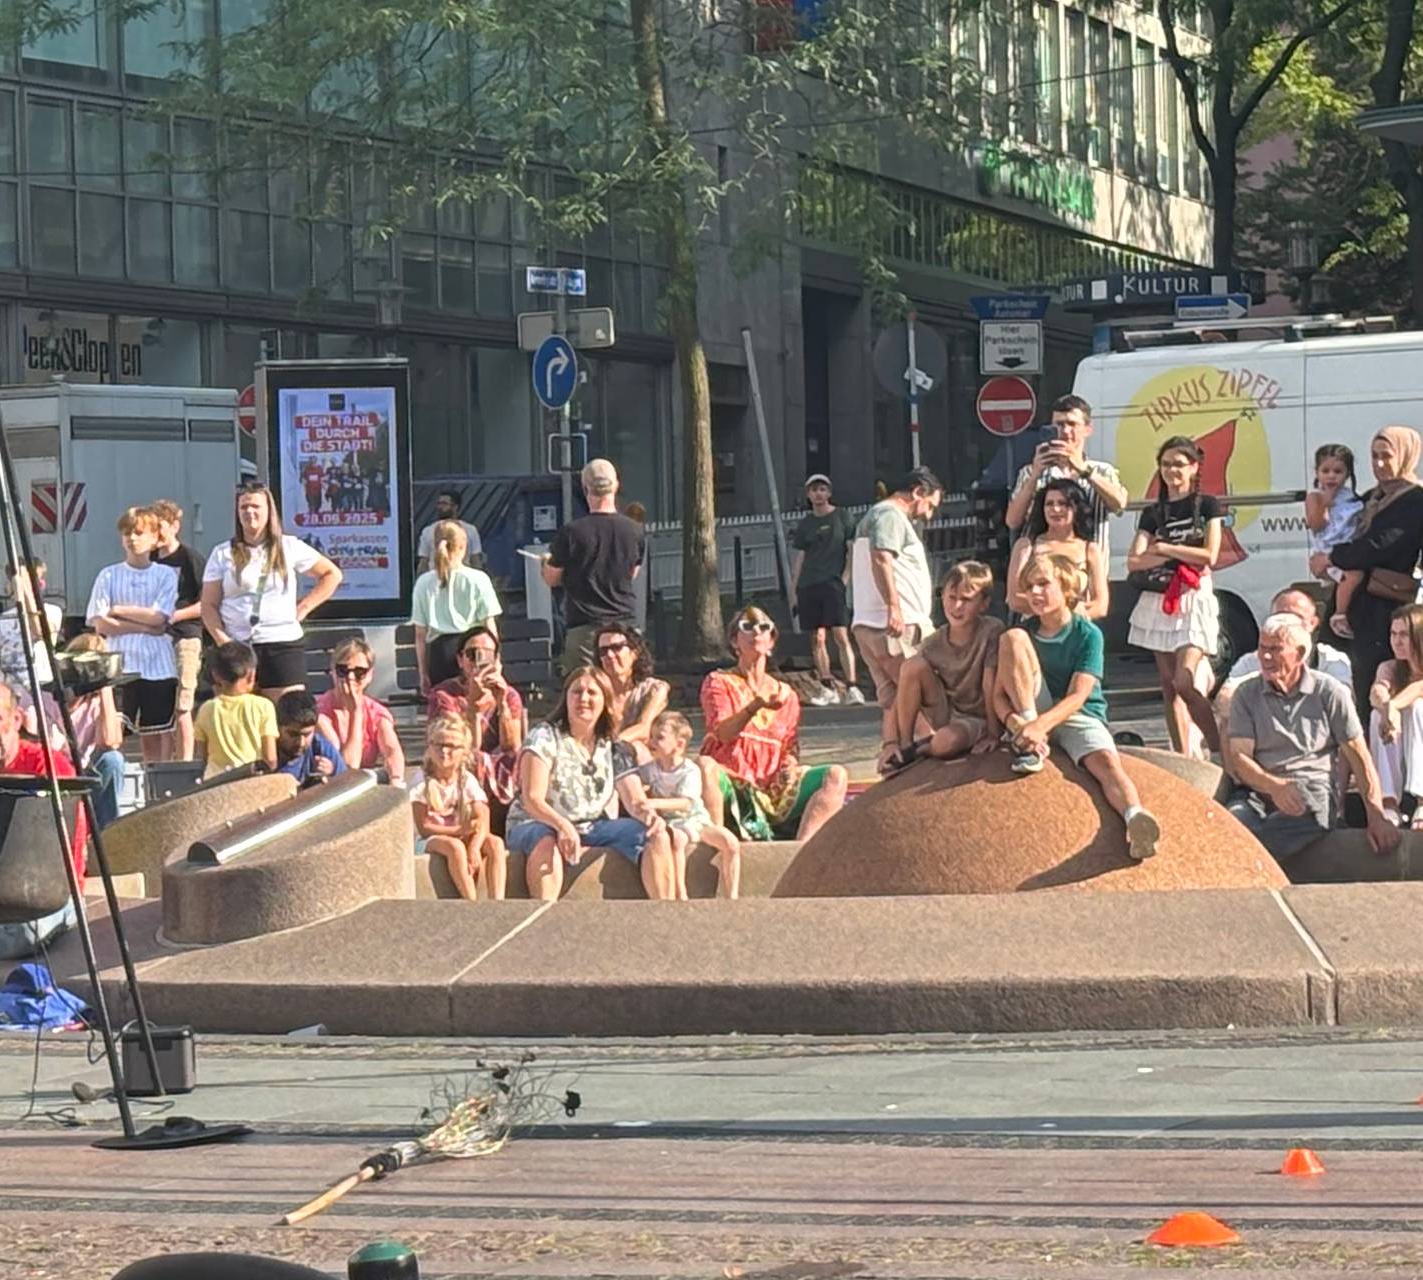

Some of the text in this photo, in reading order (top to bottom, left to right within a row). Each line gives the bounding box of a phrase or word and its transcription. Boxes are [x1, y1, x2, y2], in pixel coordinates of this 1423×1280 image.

[1122, 275, 1199, 299] KULTUR
[1000, 325, 1020, 334] Hier
[984, 335, 1038, 346] Parkschein
[302, 414, 374, 427] DEIN TRAIL
[316, 428, 359, 439] DURCH
[304, 439, 374, 452] DIE STADT!
